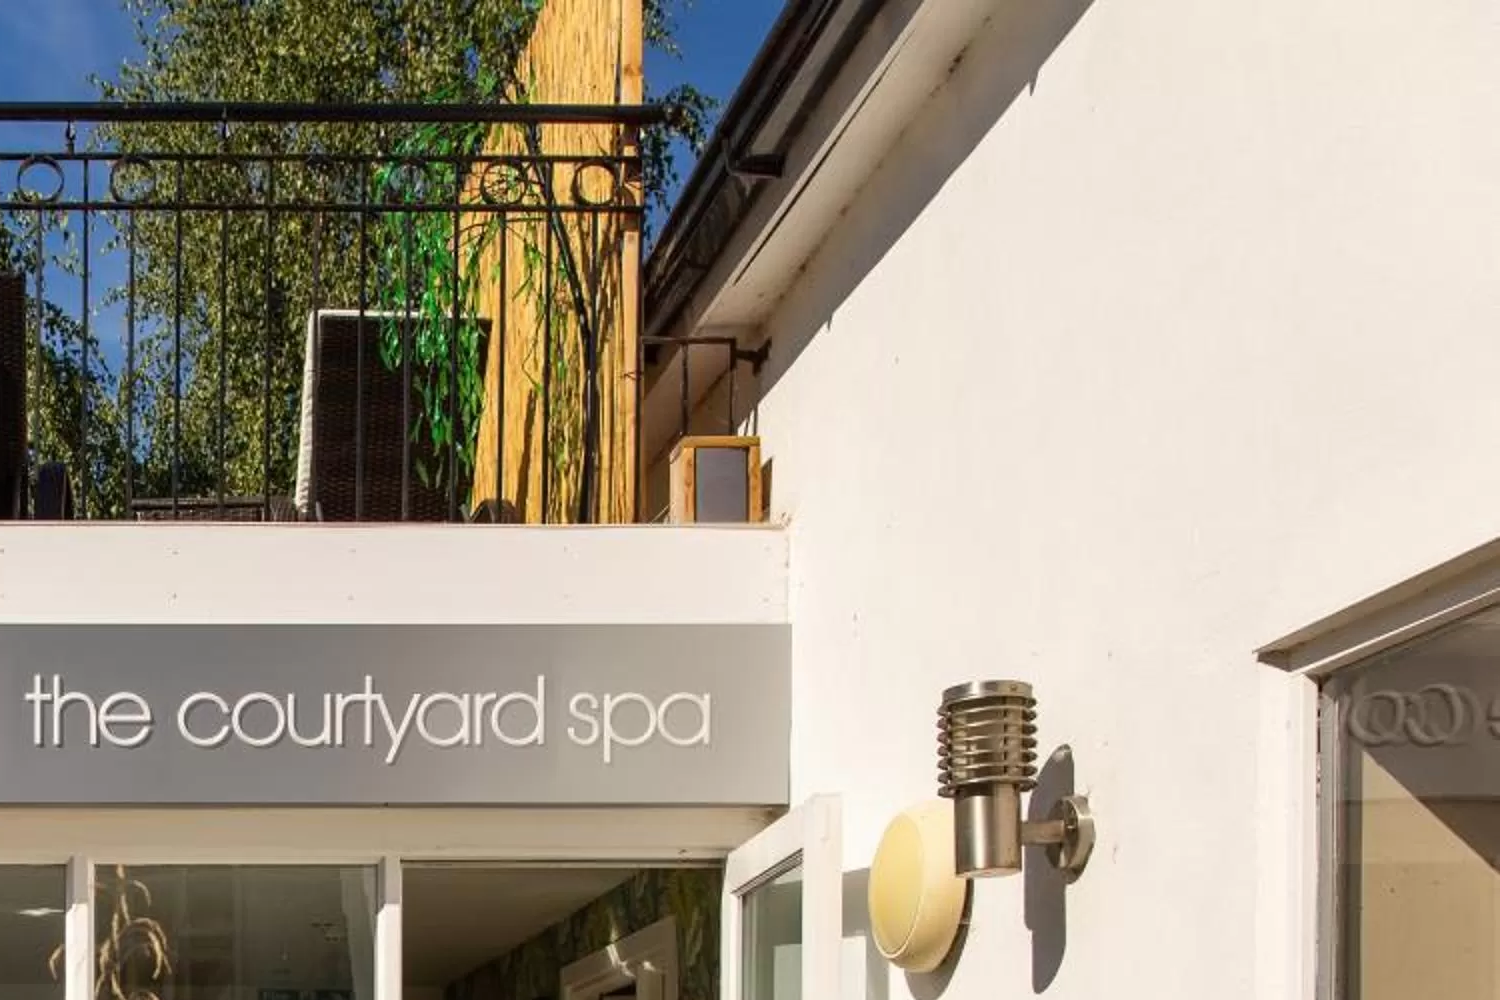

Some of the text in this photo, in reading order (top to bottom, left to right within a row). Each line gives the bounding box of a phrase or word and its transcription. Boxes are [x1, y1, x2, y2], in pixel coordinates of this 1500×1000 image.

[24, 674, 711, 764] the courtyard spa
